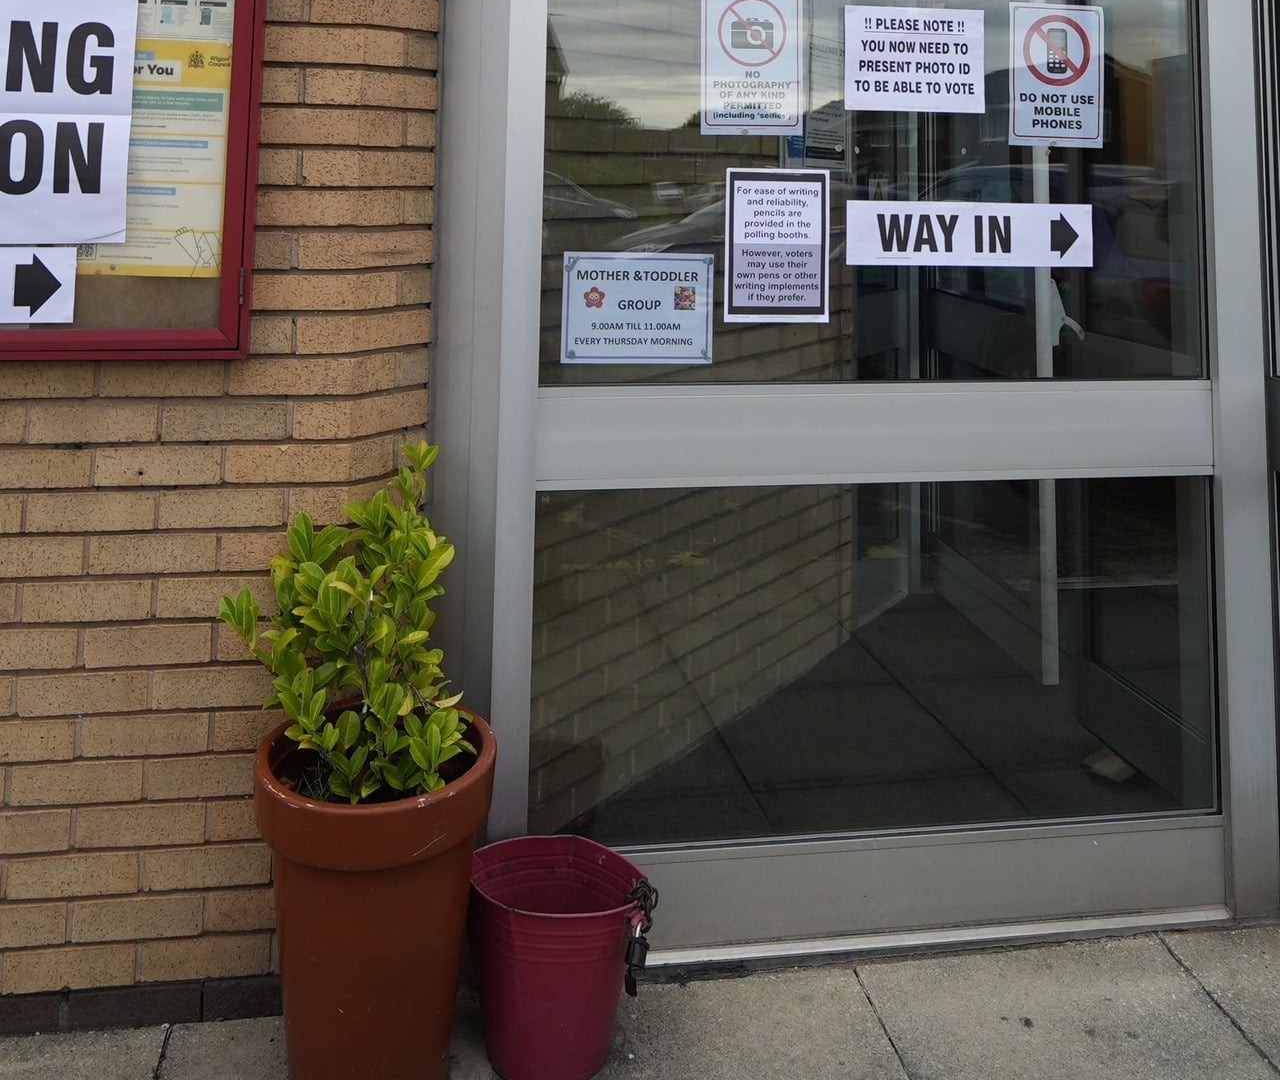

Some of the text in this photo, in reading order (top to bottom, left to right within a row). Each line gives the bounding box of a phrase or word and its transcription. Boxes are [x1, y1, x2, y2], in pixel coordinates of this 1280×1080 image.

[876, 18, 919, 31] PLEASE
[923, 20, 954, 32] NOTE
[861, 40, 968, 55] YOU NOW NEED TO
[147, 64, 174, 75] You
[859, 60, 970, 75] PRESENT PHOTO ID
[745, 71, 760, 79] NO
[713, 80, 791, 89] PHOTOGRAPHY
[854, 80, 975, 95] TO BE ABLE TO VOTE
[719, 91, 732, 99] OF
[761, 91, 785, 99] KIND
[1019, 93, 1094, 104] DO NOT USE
[724, 102, 782, 110] PERMITTED
[713, 112, 755, 121] (including
[1034, 106, 1081, 117] MOBILE
[1032, 119, 1083, 130] PHONES
[737, 186, 751, 195] For
[777, 187, 786, 195] of
[788, 187, 819, 197] writing
[766, 198, 809, 208] reliability,
[754, 209, 785, 219] pencils
[744, 220, 783, 229] provided
[797, 220, 811, 228] the
[744, 230, 811, 240] polling booths.
[876, 214, 1011, 253] WAY IN
[741, 249, 783, 258] However,
[747, 261, 766, 269] may
[787, 260, 808, 268] their
[576, 270, 699, 282] MOTHER &TODDLER
[758, 272, 780, 281] pens
[735, 282, 819, 292] writing implements
[747, 293, 807, 303] if they prefer.
[617, 299, 662, 310] GROUP
[591, 322, 681, 330] 9.00AM TILL 11.00AM
[574, 337, 693, 346] EVERY THURSDAY MORNING
